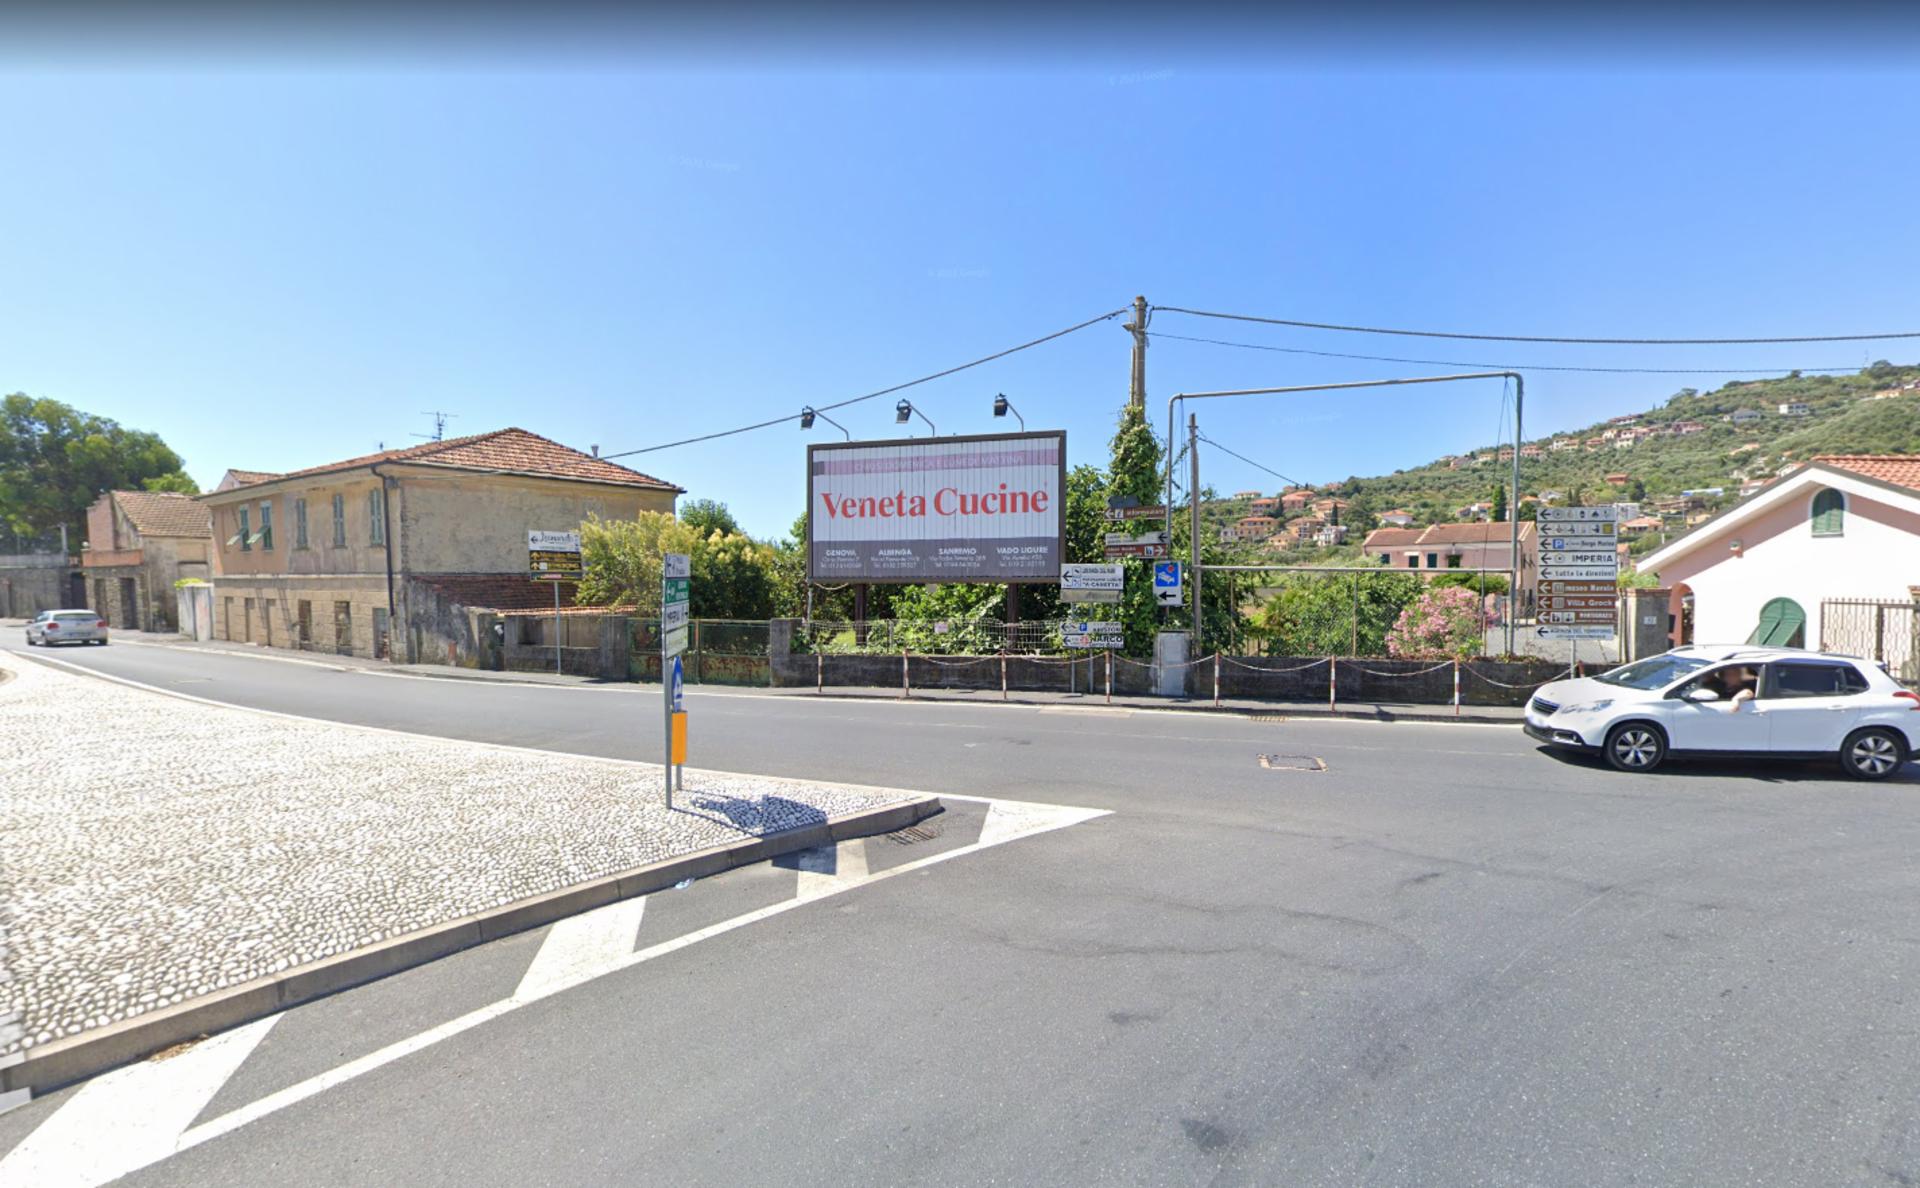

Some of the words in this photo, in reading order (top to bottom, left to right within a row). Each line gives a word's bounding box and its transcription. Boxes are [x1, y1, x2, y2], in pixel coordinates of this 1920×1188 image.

[821, 489, 926, 520] Veneta
[933, 483, 1049, 517] Cucine
[878, 548, 912, 556] ALBENGA
[938, 547, 977, 555] SANREMO
[996, 546, 1020, 554] VADO
[1021, 545, 1049, 553] LIGURE
[1571, 554, 1613, 562] IMPERIA
[1555, 569, 1574, 577] tutte
[1585, 569, 1615, 577] direzioni
